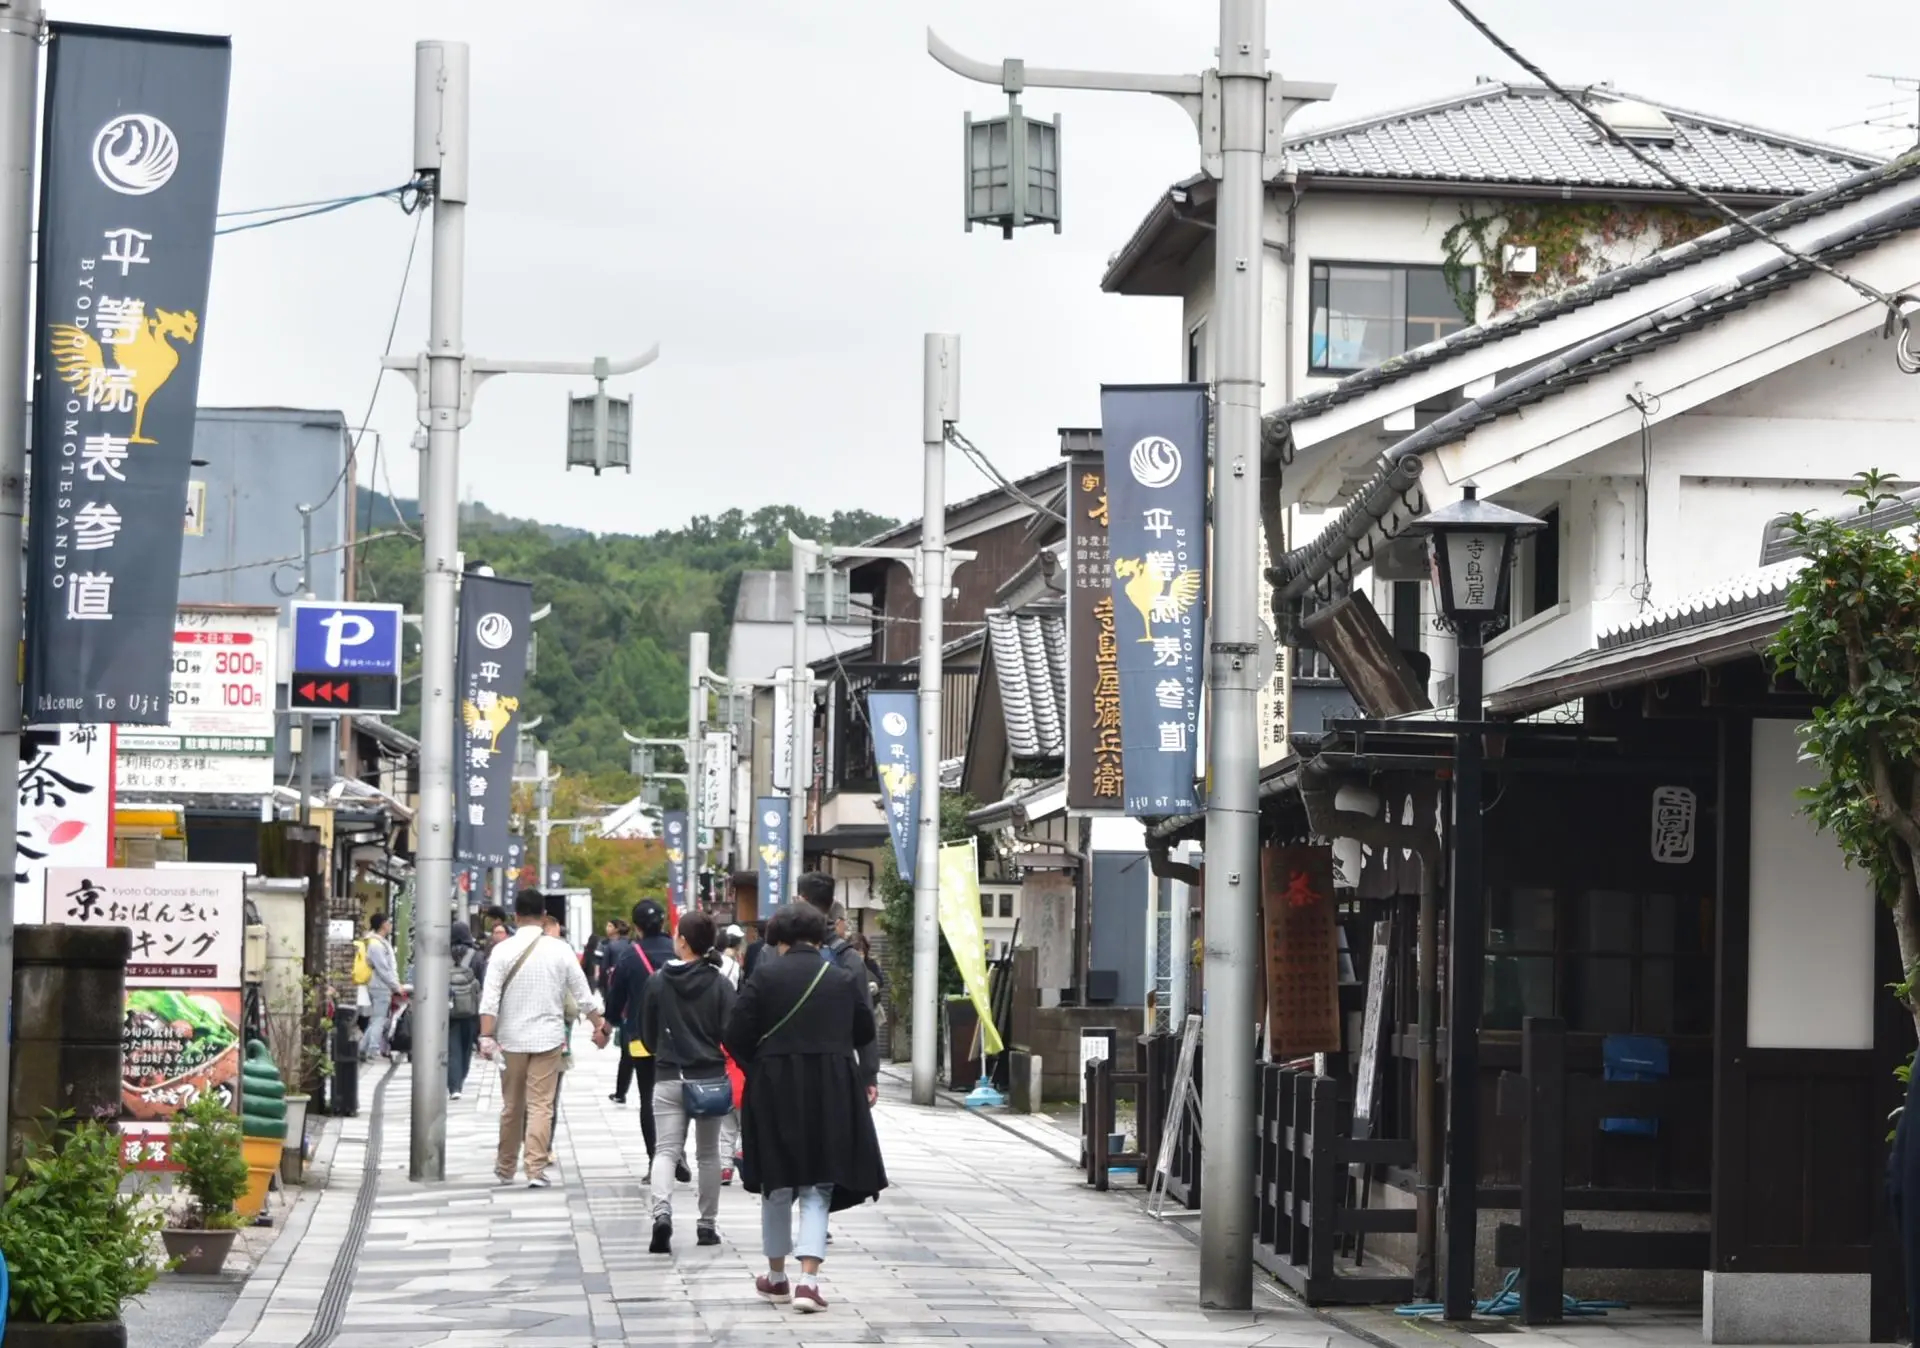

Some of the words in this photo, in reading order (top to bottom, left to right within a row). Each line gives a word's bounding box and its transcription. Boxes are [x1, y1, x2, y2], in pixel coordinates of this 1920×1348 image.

[66, 227, 153, 621] 平等院表参道
[1464, 538, 1484, 605] 寺島屋
[95, 693, 117, 709] To
[129, 693, 160, 715] Uji
[112, 888, 141, 897] Kyoto
[190, 888, 219, 897] Buffet
